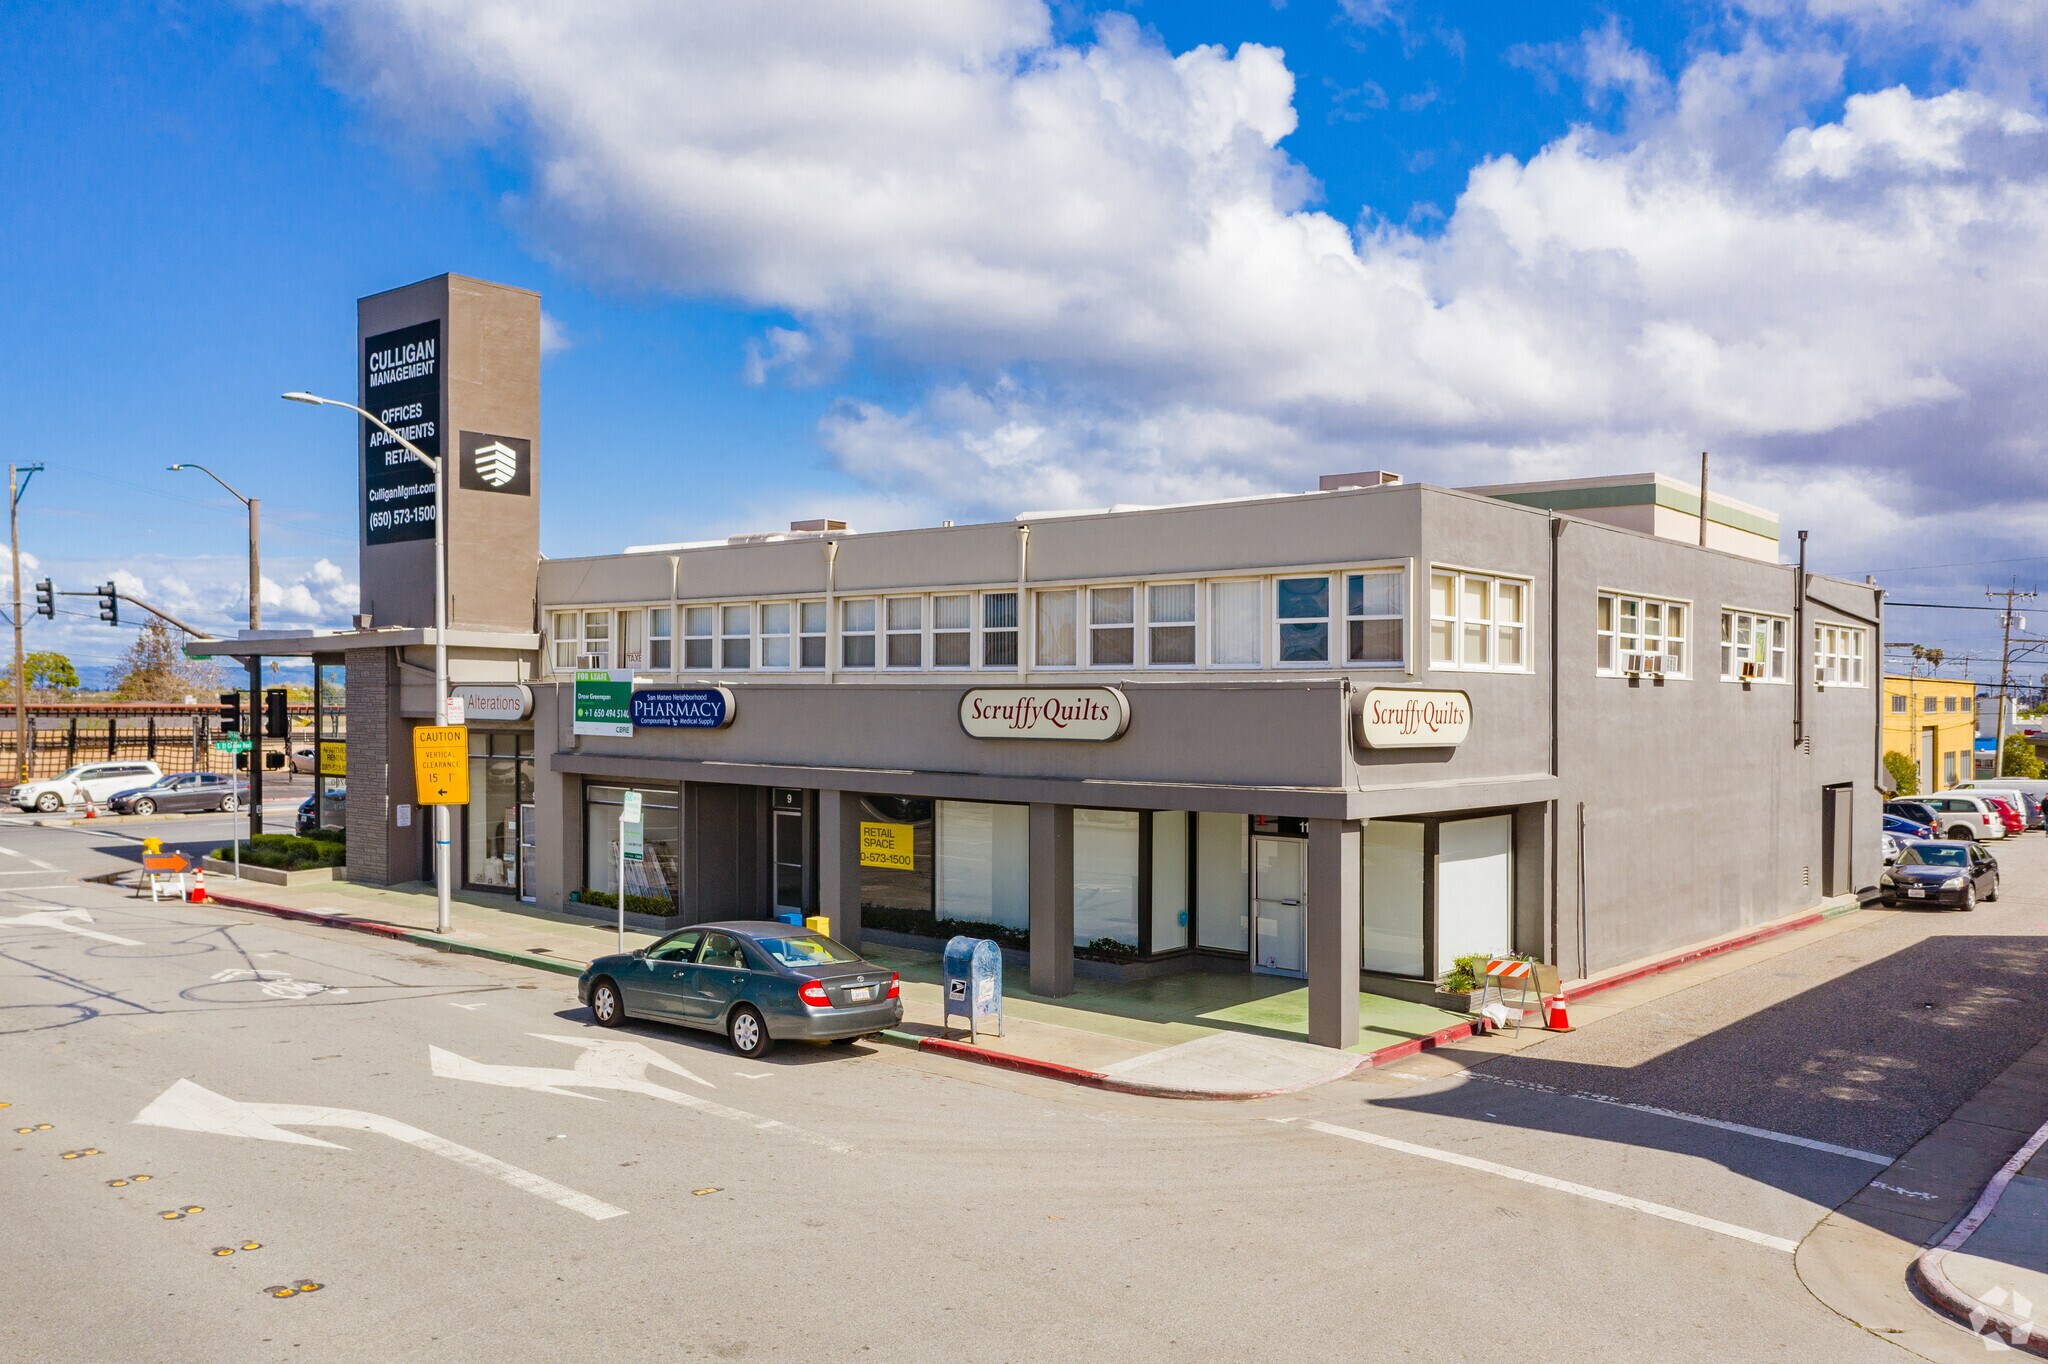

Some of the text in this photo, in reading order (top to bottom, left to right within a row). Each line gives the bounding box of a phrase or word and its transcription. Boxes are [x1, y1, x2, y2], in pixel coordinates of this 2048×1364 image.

[370, 339, 435, 372] CULLIGAN
[370, 360, 435, 388] MANAGEMENT
[381, 402, 423, 424] OFFICES
[369, 421, 435, 448] APARTMENTS
[369, 483, 436, 502] CulliganMgmt.com
[369, 505, 436, 531] (650) 573-1500
[577, 673, 608, 681] FOR LEASE
[467, 694, 521, 711] Alterations
[646, 693, 656, 701] San
[672, 693, 708, 702] Neighborhood
[594, 708, 605, 718] 650
[634, 700, 721, 717] PHARMACY
[640, 717, 671, 726] Compounding
[698, 718, 715, 726] Supply
[616, 726, 630, 734] CBRE
[419, 731, 461, 742] CAUTION
[425, 751, 456, 759] VERTICAL
[422, 761, 460, 769] CLEARANCE
[786, 794, 792, 804] 9
[863, 827, 895, 839] RETAIL
[863, 838, 895, 850] SPACE
